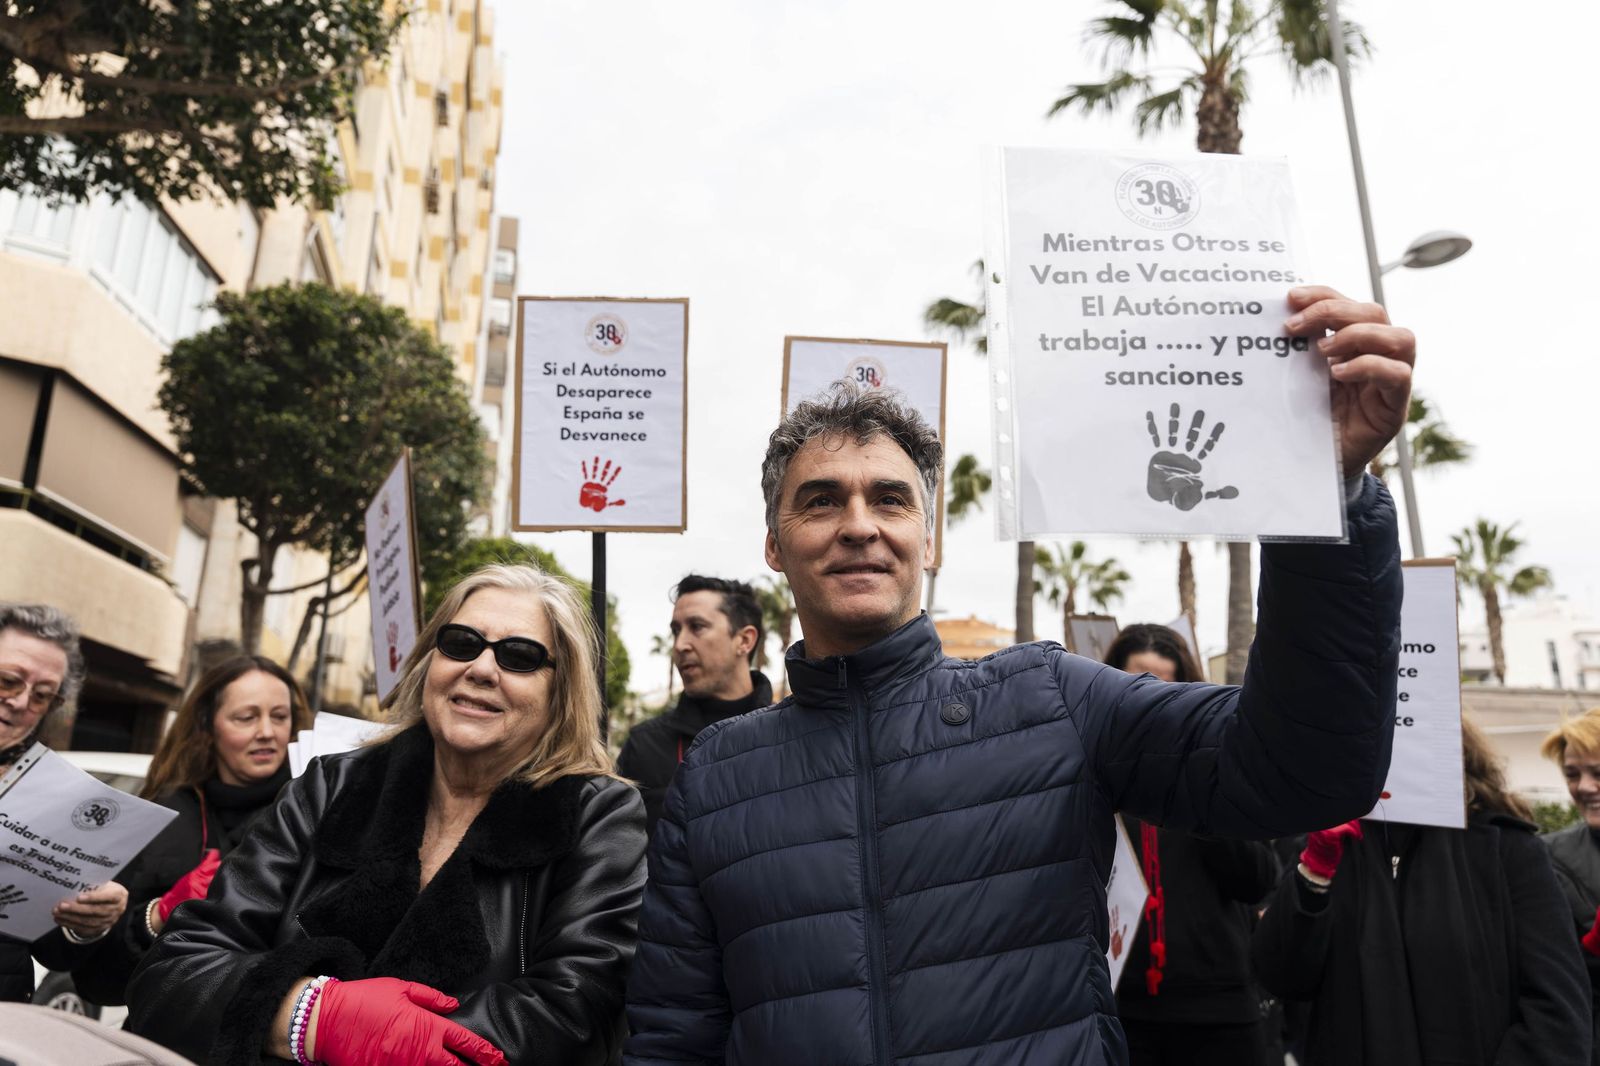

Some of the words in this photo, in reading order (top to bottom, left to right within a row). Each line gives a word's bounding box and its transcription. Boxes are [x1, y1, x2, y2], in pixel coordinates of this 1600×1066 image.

[1042, 233, 1164, 253] Mientras
[1172, 233, 1249, 253] Otros
[1257, 238, 1286, 253] se
[1029, 265, 1088, 285] Van
[1096, 263, 1131, 284] de
[1081, 296, 1105, 317] El
[1112, 296, 1263, 317] Autónomo
[1039, 329, 1147, 356] trabaja
[1210, 335, 1229, 356] y
[1237, 334, 1309, 358] paga
[542, 362, 558, 377] Si
[562, 362, 576, 377] el
[580, 362, 667, 378] Autónomo
[1104, 364, 1244, 386] sanciones
[556, 384, 653, 402] Desaparece
[563, 405, 623, 423] España
[628, 410, 645, 421] se
[560, 427, 648, 442] Desvanece
[9, 843, 25, 854] es
[26, 848, 81, 876] Trabajar.
[40, 838, 50, 847] a
[51, 843, 69, 854] un
[69, 847, 119, 869] Familiar
[38, 869, 79, 890] Social
